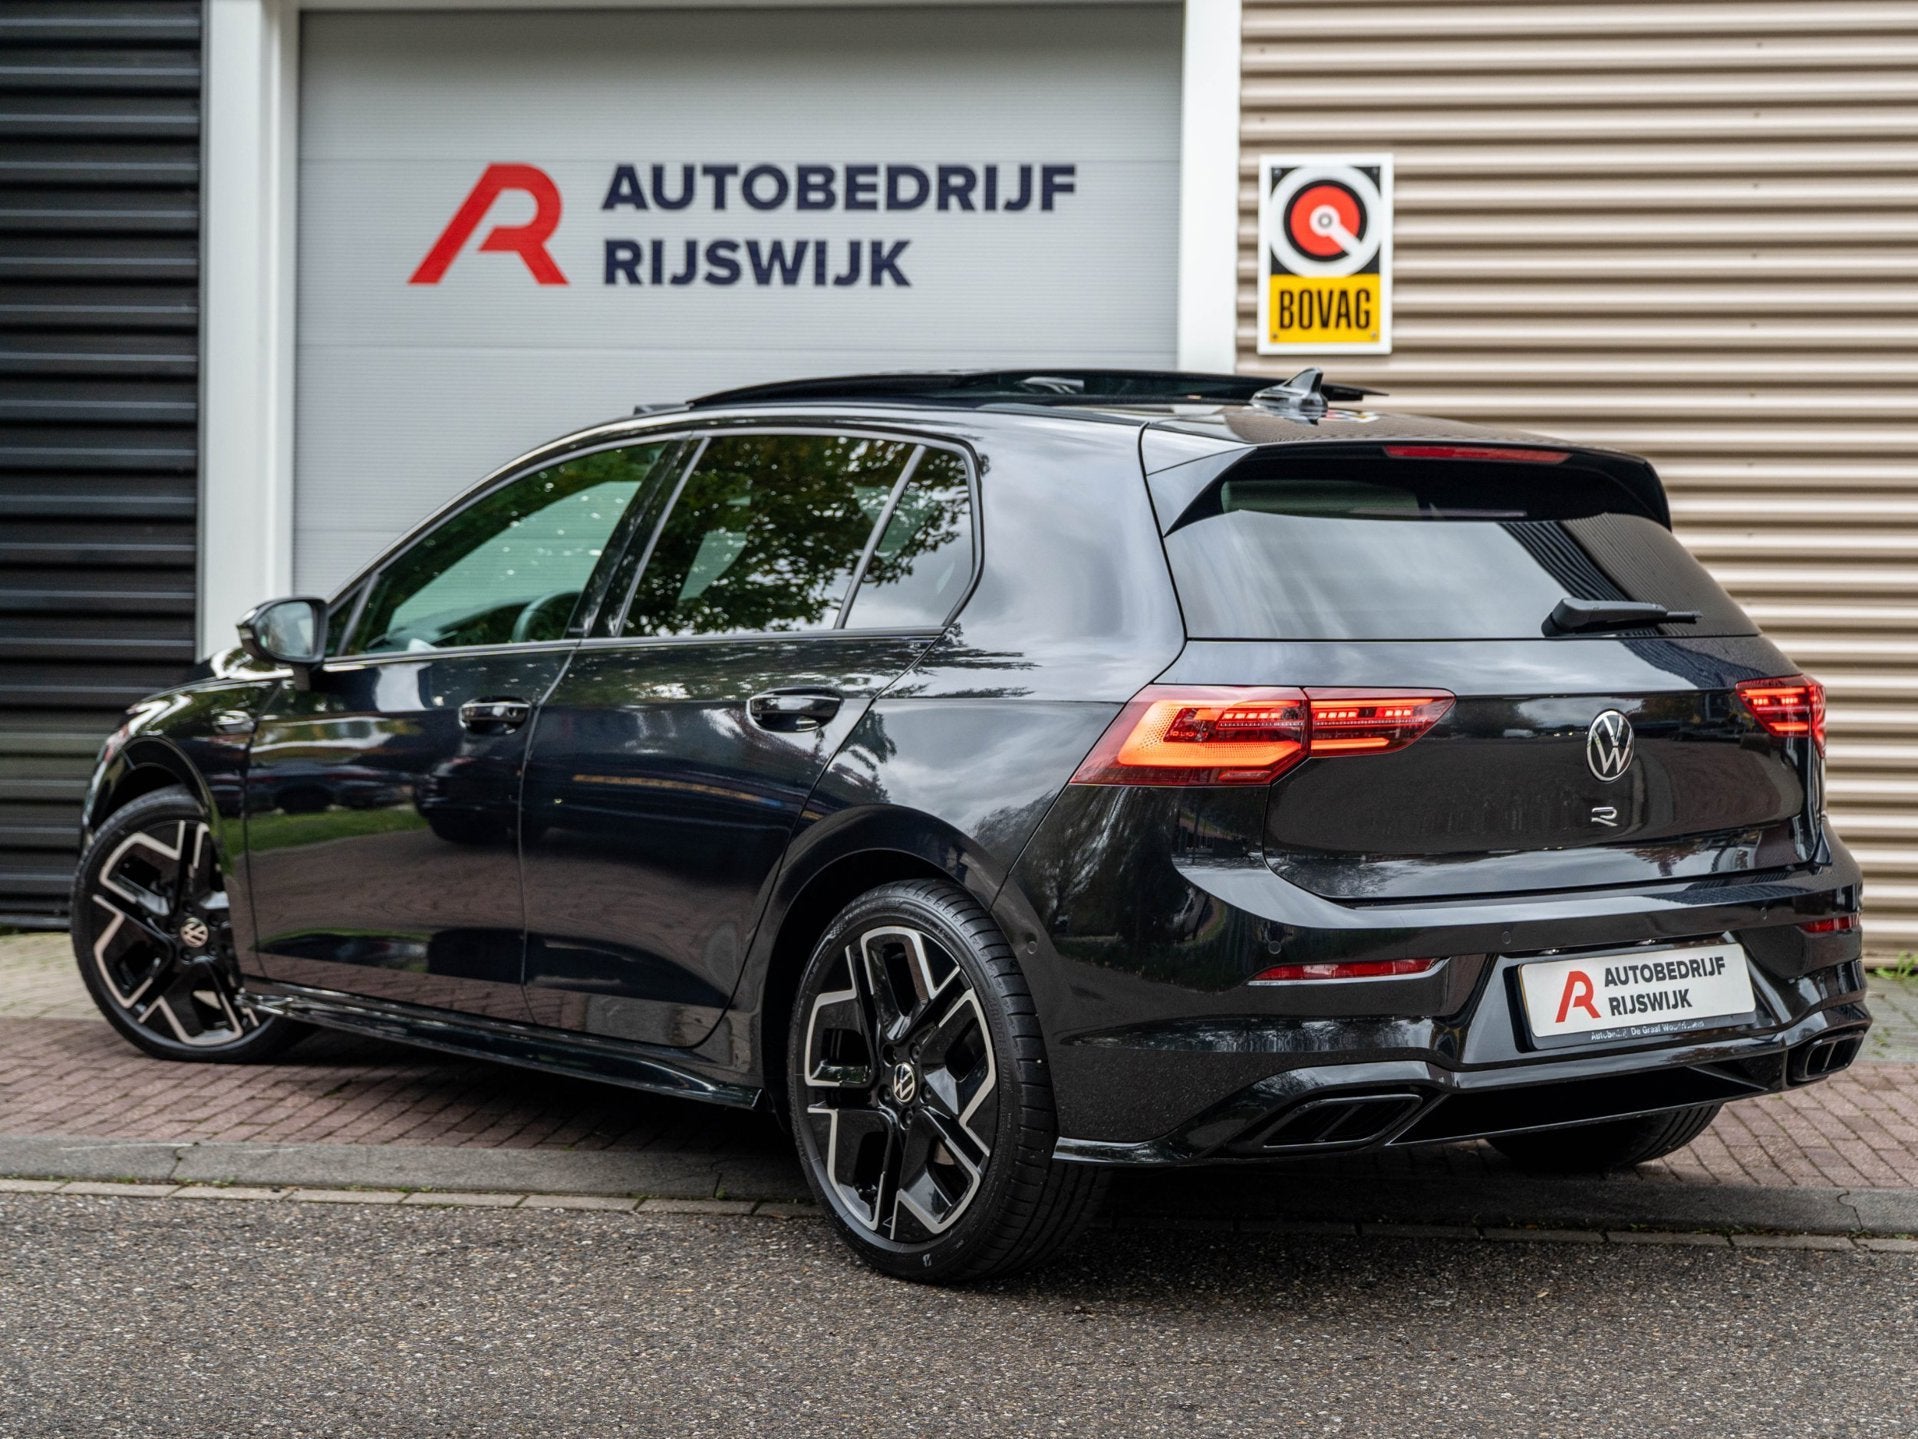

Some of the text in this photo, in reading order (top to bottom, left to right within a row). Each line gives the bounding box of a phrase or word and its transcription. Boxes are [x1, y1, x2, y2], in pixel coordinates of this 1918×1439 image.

[601, 163, 1077, 213] AUTOBEDRIJF
[603, 238, 913, 288] RIJSWIJK
[1278, 289, 1371, 330] BOVAG
[1604, 956, 1726, 987] AUTOBEDRIJF
[1608, 989, 1692, 1016] RIJSWIJK
